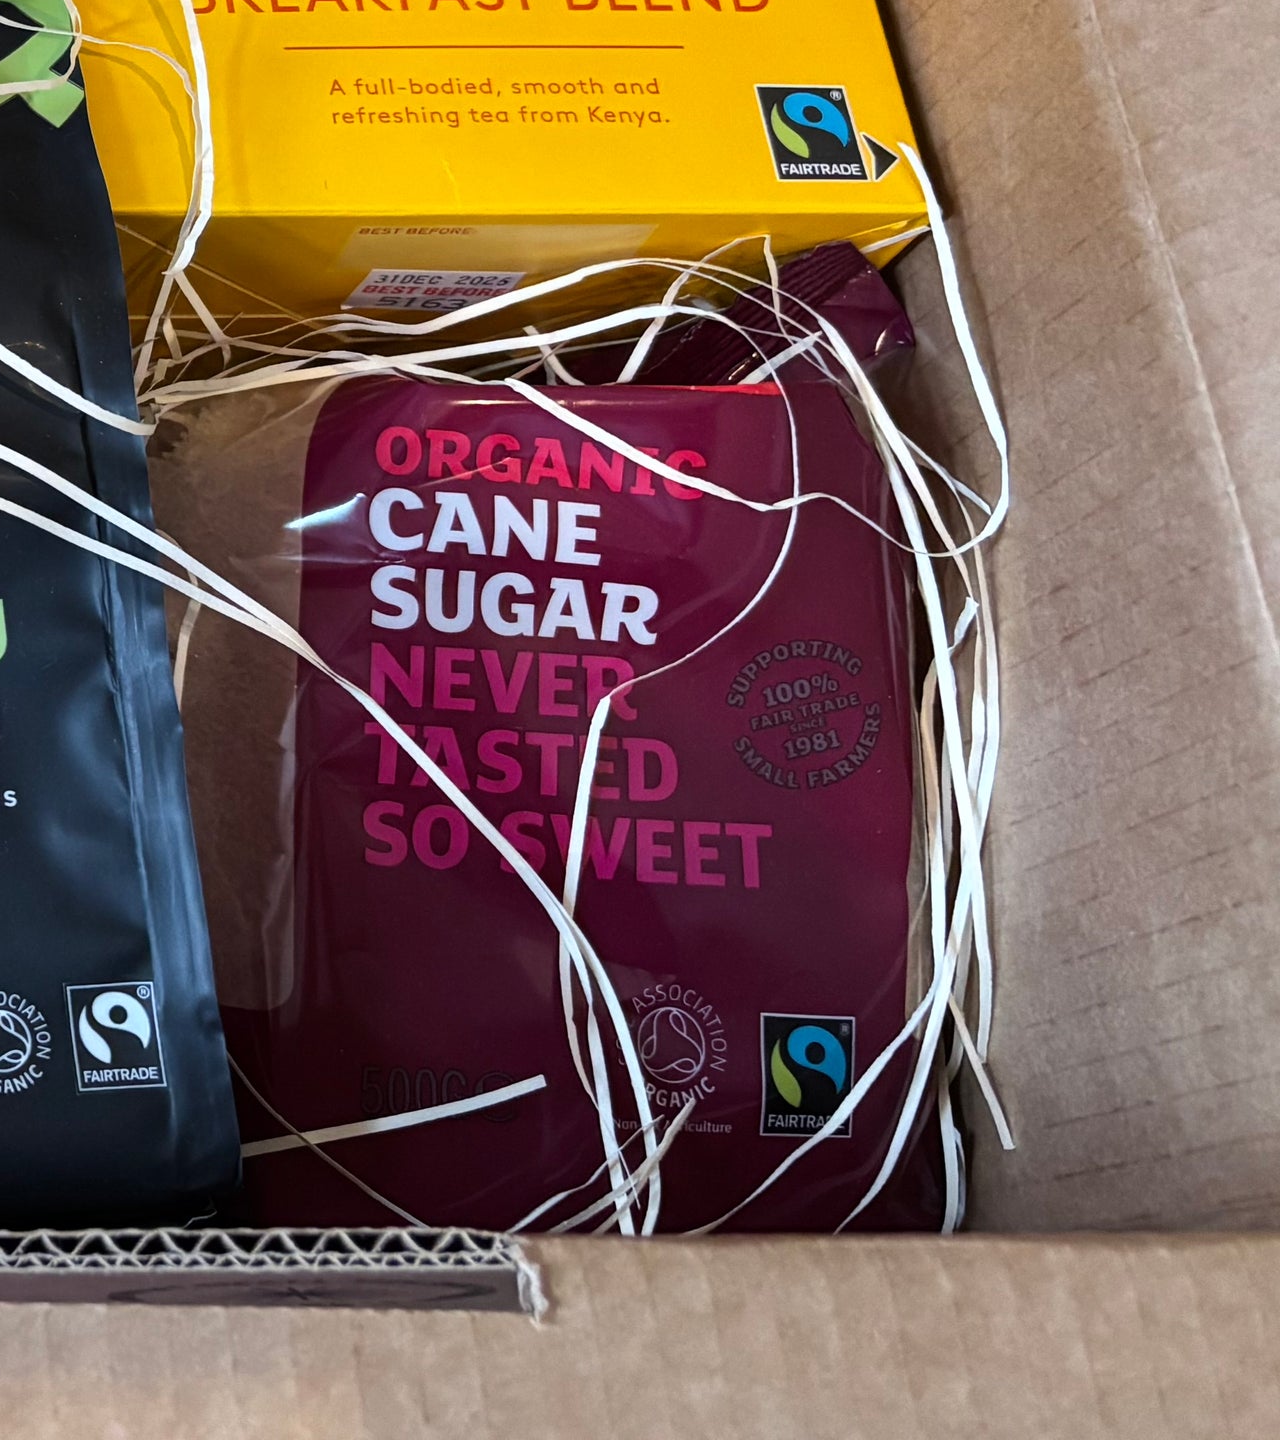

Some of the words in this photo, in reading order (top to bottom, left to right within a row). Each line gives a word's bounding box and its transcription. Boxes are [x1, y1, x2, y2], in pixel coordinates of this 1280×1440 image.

[329, 79, 346, 95] A
[354, 78, 502, 99] full-bodied,
[511, 79, 604, 96] smooth
[614, 78, 660, 95] and
[331, 106, 460, 128] refreshing
[469, 108, 510, 124] tea
[518, 105, 579, 124] from
[588, 108, 671, 128] Kenya.
[781, 164, 862, 175] FAIRTRADE
[361, 286, 421, 294] BEST
[423, 286, 508, 298] BEFORE
[375, 426, 707, 501] ORGANIC
[369, 487, 602, 567] CANE
[370, 565, 659, 645] SUGAR
[369, 642, 638, 721] NEVER
[728, 641, 862, 707] SUPPORTING
[763, 673, 838, 707] 100%
[751, 711, 794, 730] FAIR
[798, 693, 859, 717] TRADE
[784, 730, 840, 758] 1981
[364, 722, 679, 803] TASTED
[734, 737, 799, 788] SMALL
[807, 703, 880, 787] FARMERS
[363, 800, 469, 869] SO
[499, 810, 772, 889] SWEET
[632, 984, 727, 1072] ASSOCIATION
[83, 1067, 159, 1083] FAIRTRADE
